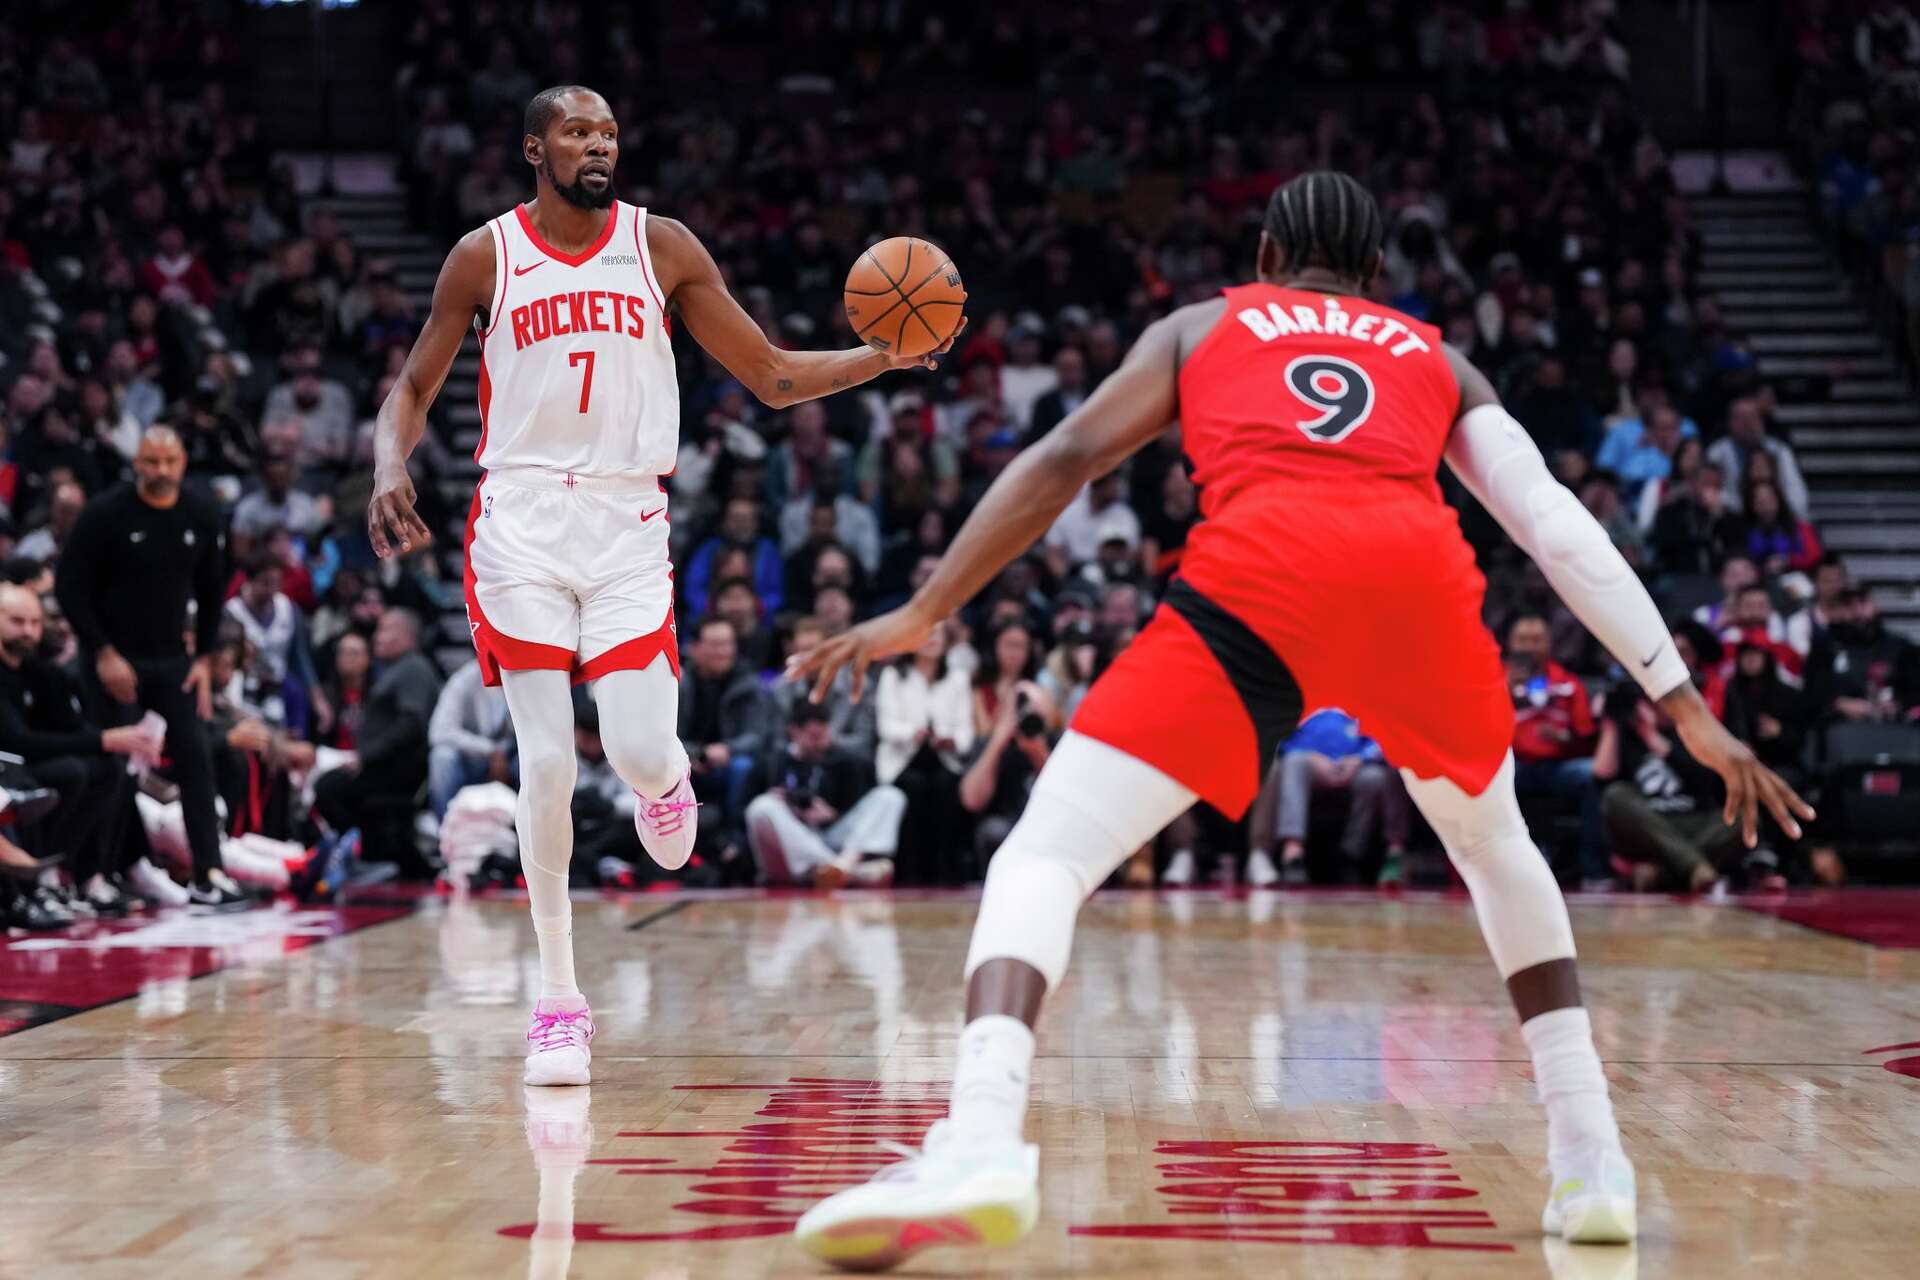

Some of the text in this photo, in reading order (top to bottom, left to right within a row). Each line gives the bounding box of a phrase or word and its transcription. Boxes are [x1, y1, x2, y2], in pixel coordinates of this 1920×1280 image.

[511, 291, 645, 351] ROCKETS
[1237, 303, 1430, 357] BARRETT
[569, 351, 595, 413] 7
[1284, 355, 1375, 444] 9
[1068, 1140, 1516, 1252] Arena
